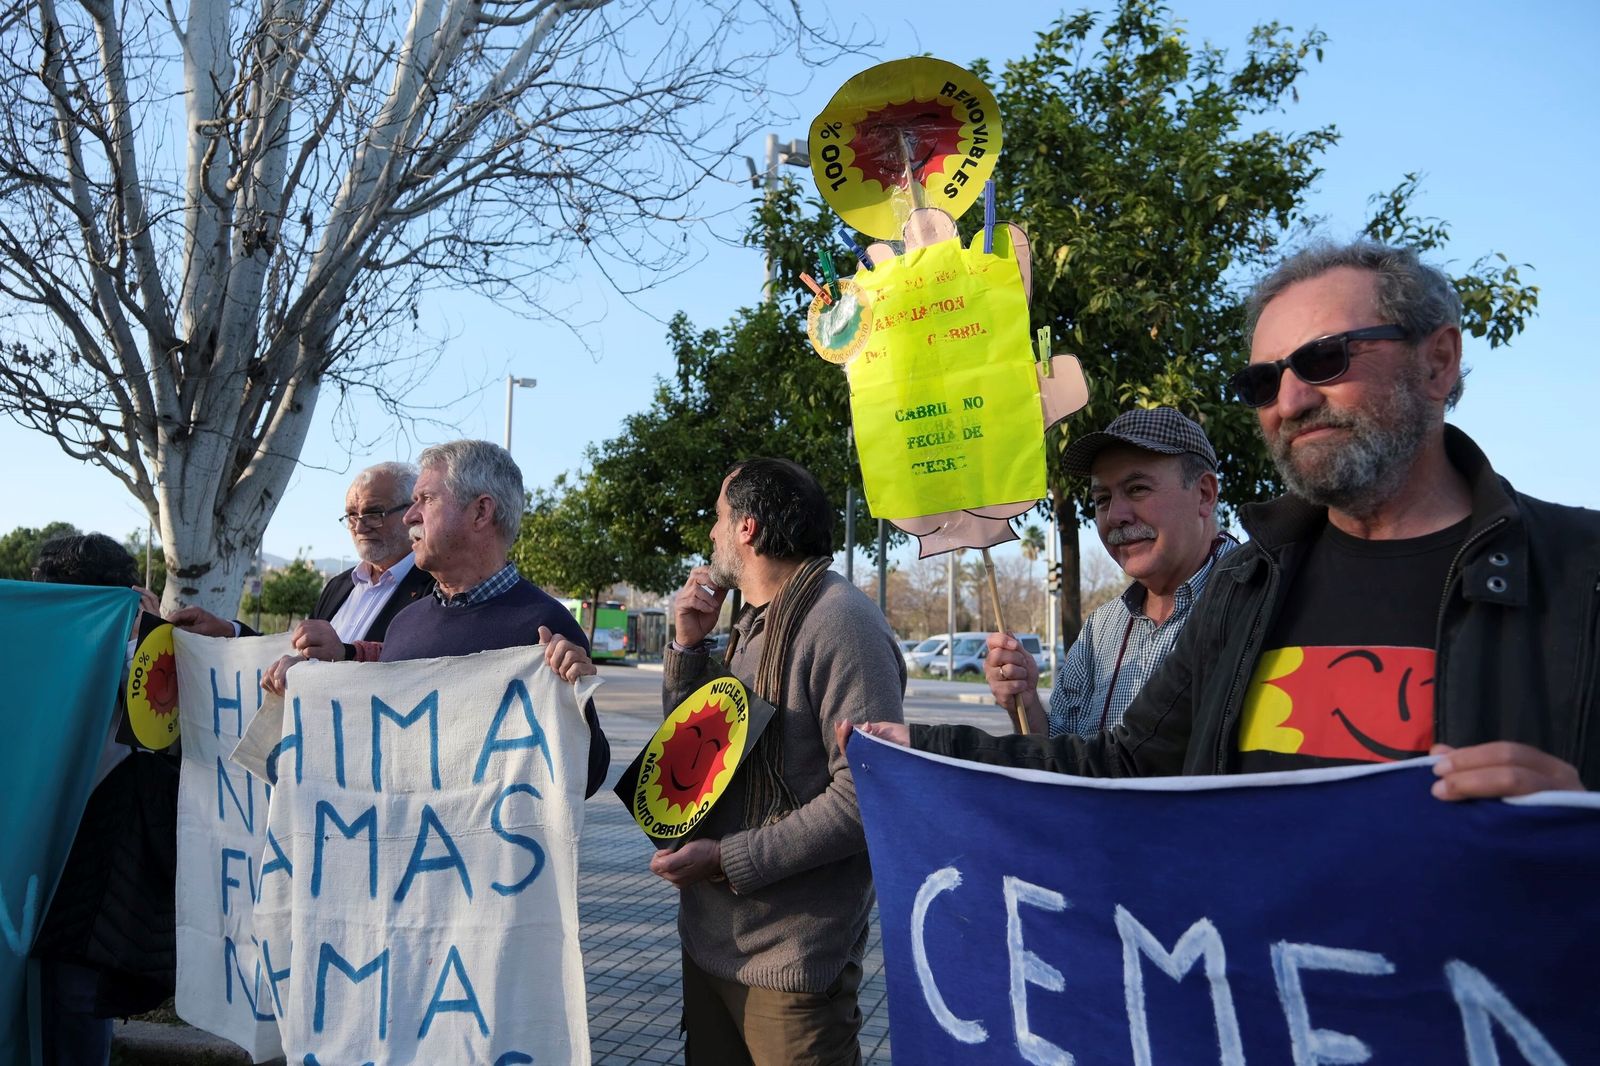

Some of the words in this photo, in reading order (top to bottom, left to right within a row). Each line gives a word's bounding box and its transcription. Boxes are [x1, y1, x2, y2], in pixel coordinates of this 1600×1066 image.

[821, 144, 848, 192] 100
[939, 81, 989, 199] RENOVABLES
[962, 396, 984, 411] NO
[963, 426, 984, 441] DE
[132, 667, 143, 699] 100
[710, 682, 747, 723] NUCLEAR?
[636, 789, 653, 827] MUITO
[651, 800, 710, 836] OBRIGADO
